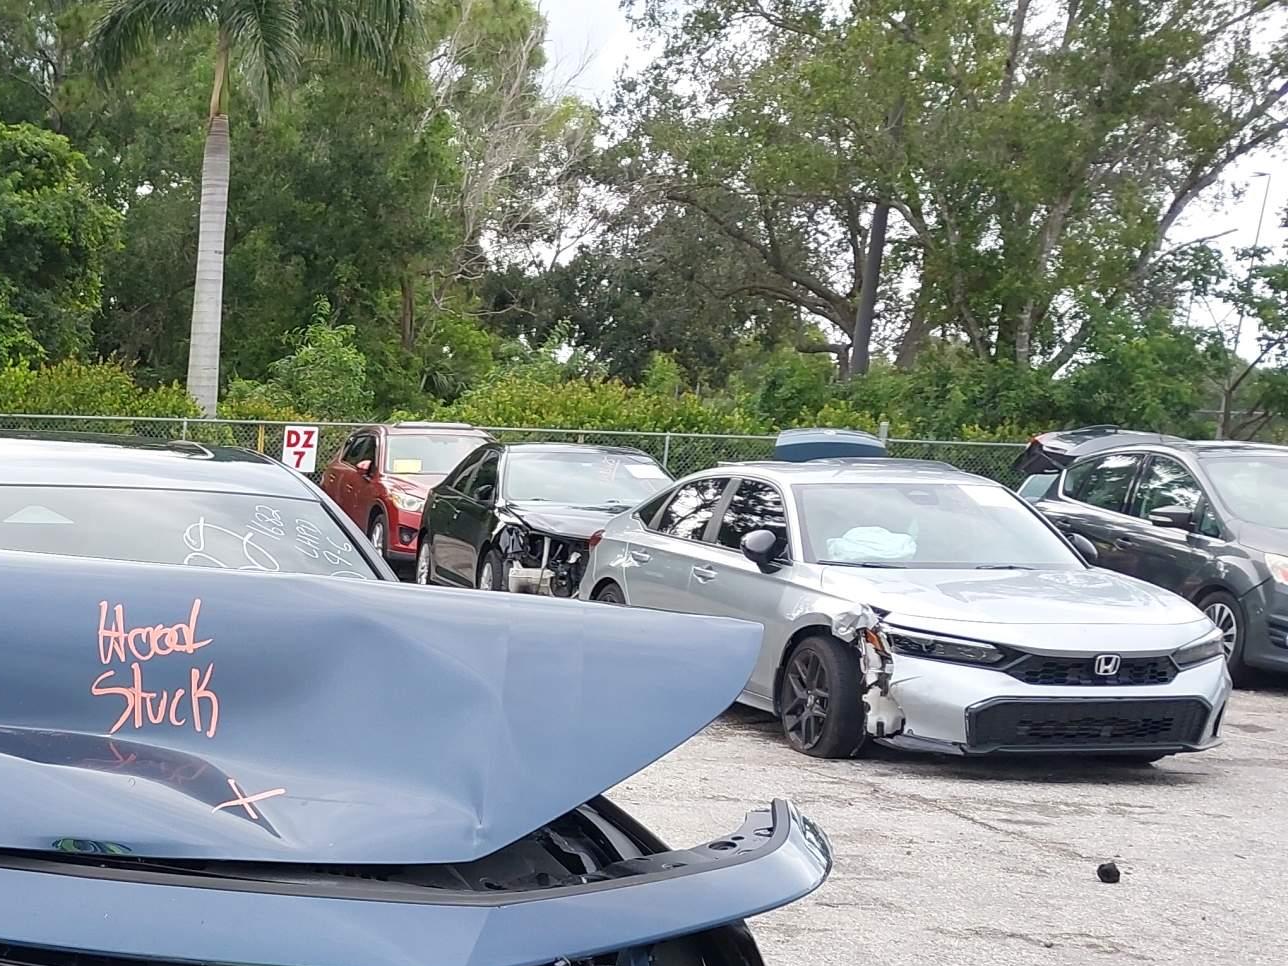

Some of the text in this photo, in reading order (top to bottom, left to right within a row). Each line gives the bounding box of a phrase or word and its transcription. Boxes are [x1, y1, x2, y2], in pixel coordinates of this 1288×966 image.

[286, 429, 316, 449] DZ
[292, 450, 306, 468] 7
[98, 598, 213, 664] Hood
